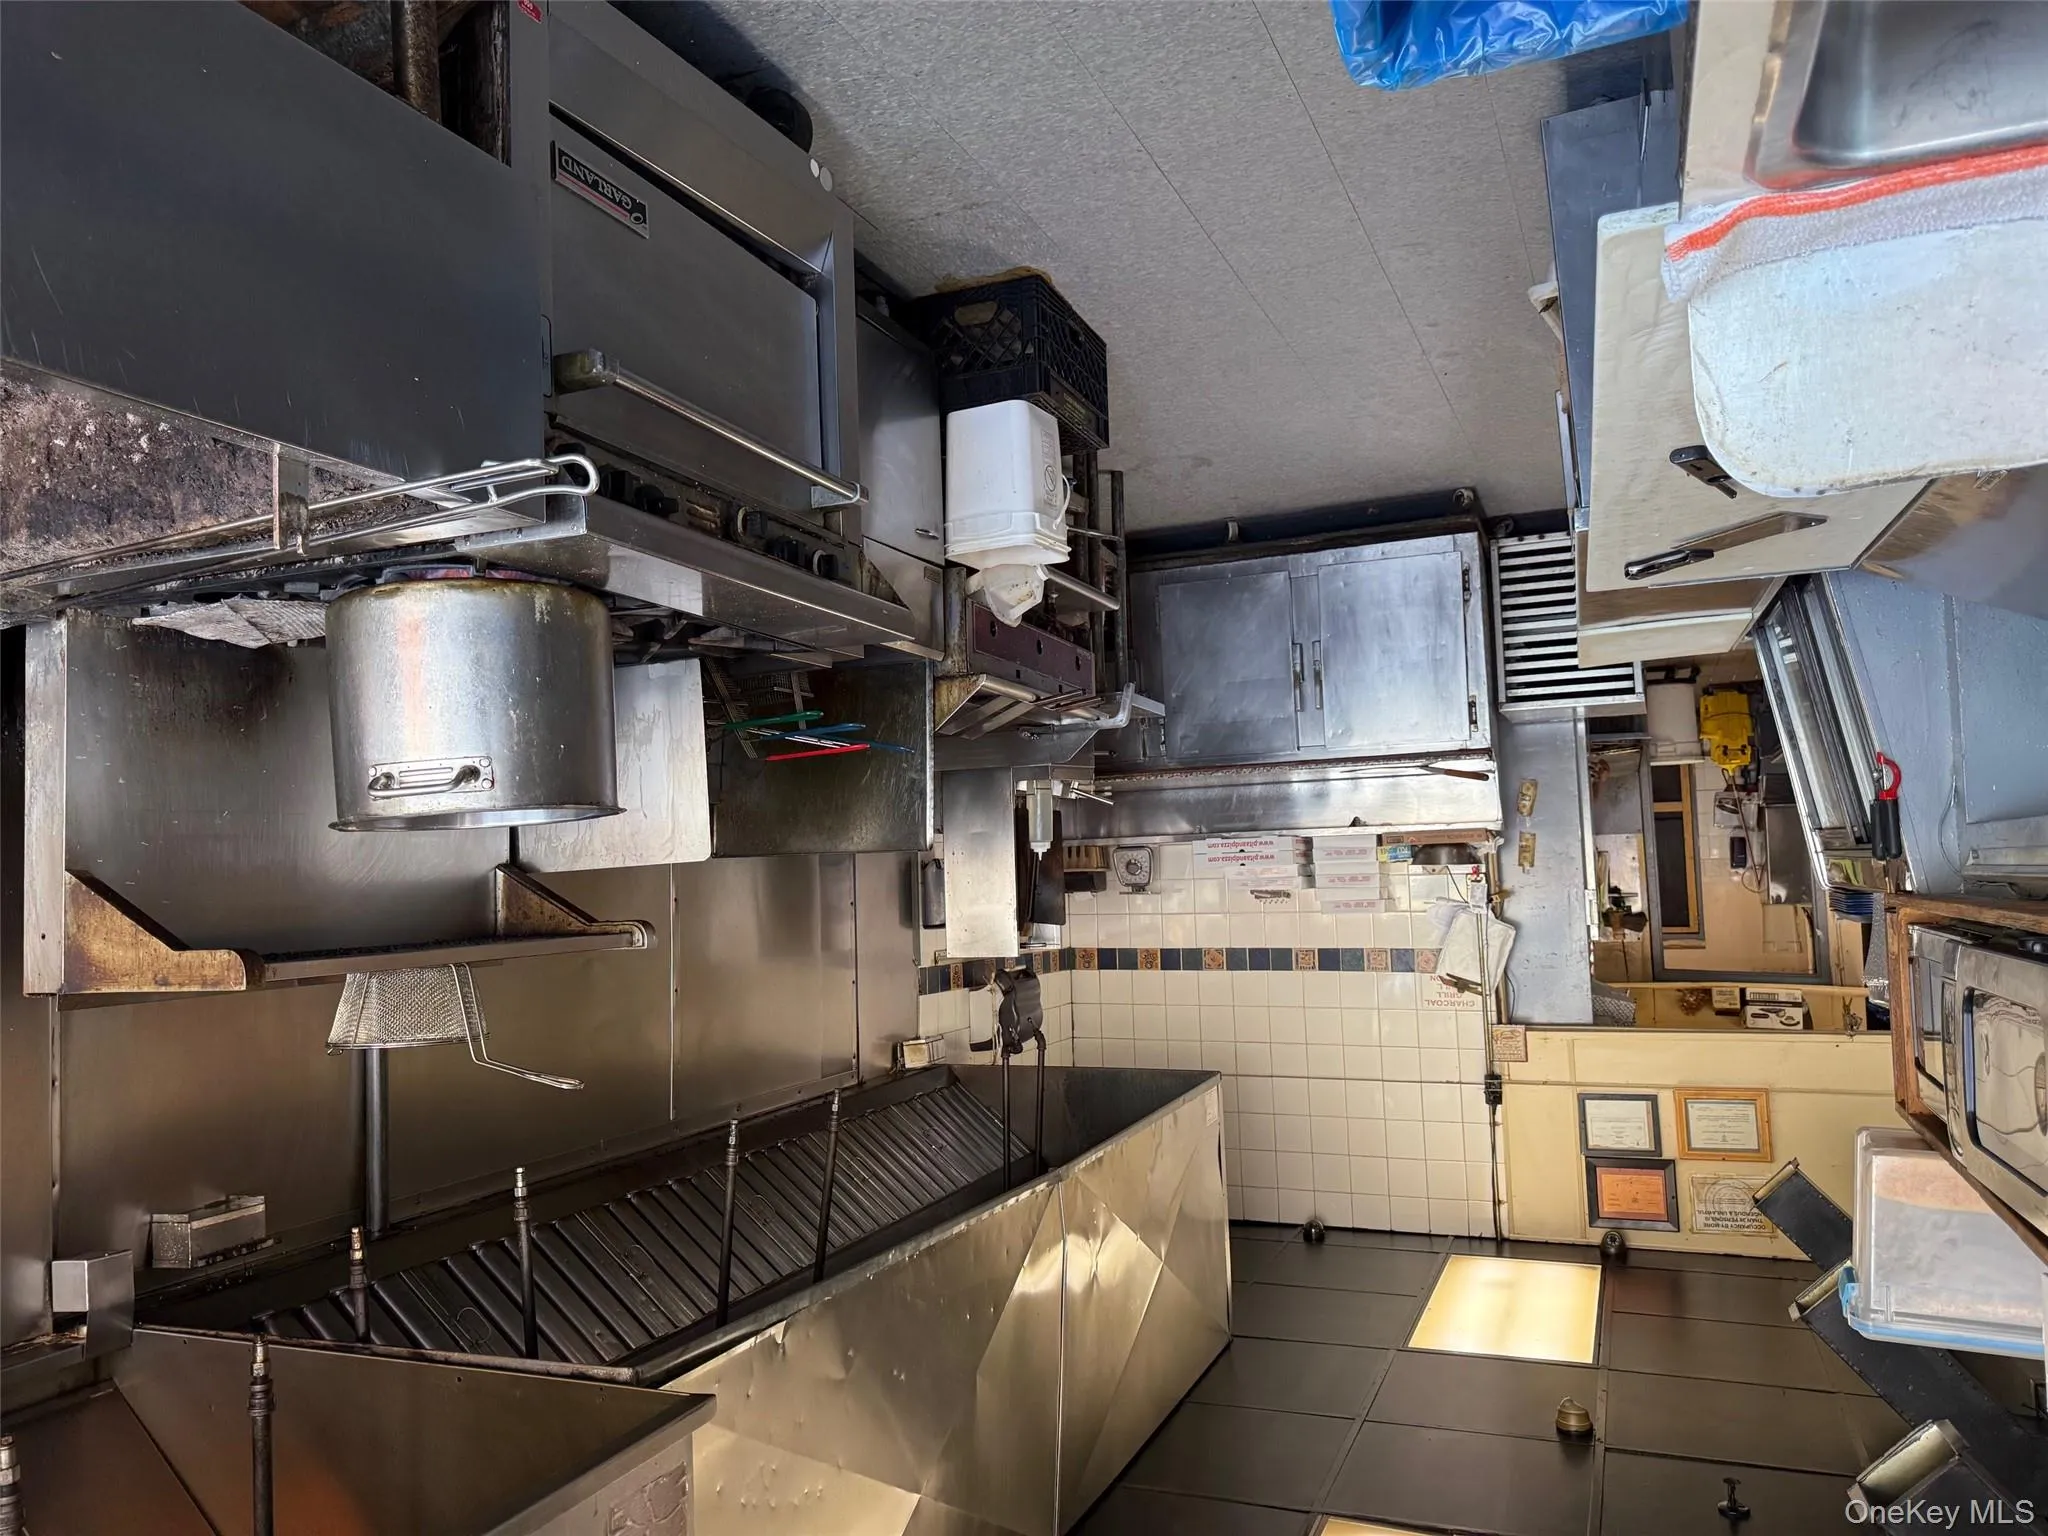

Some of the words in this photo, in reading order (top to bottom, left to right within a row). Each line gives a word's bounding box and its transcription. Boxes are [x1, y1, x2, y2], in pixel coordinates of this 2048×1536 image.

[561, 155, 632, 210] GARLAND
[1207, 840, 1274, 849] www.pitaandpizza.com
[1207, 854, 1275, 863] www.pitaandpizza.com
[1424, 999, 1475, 1007] CHARCOAL
